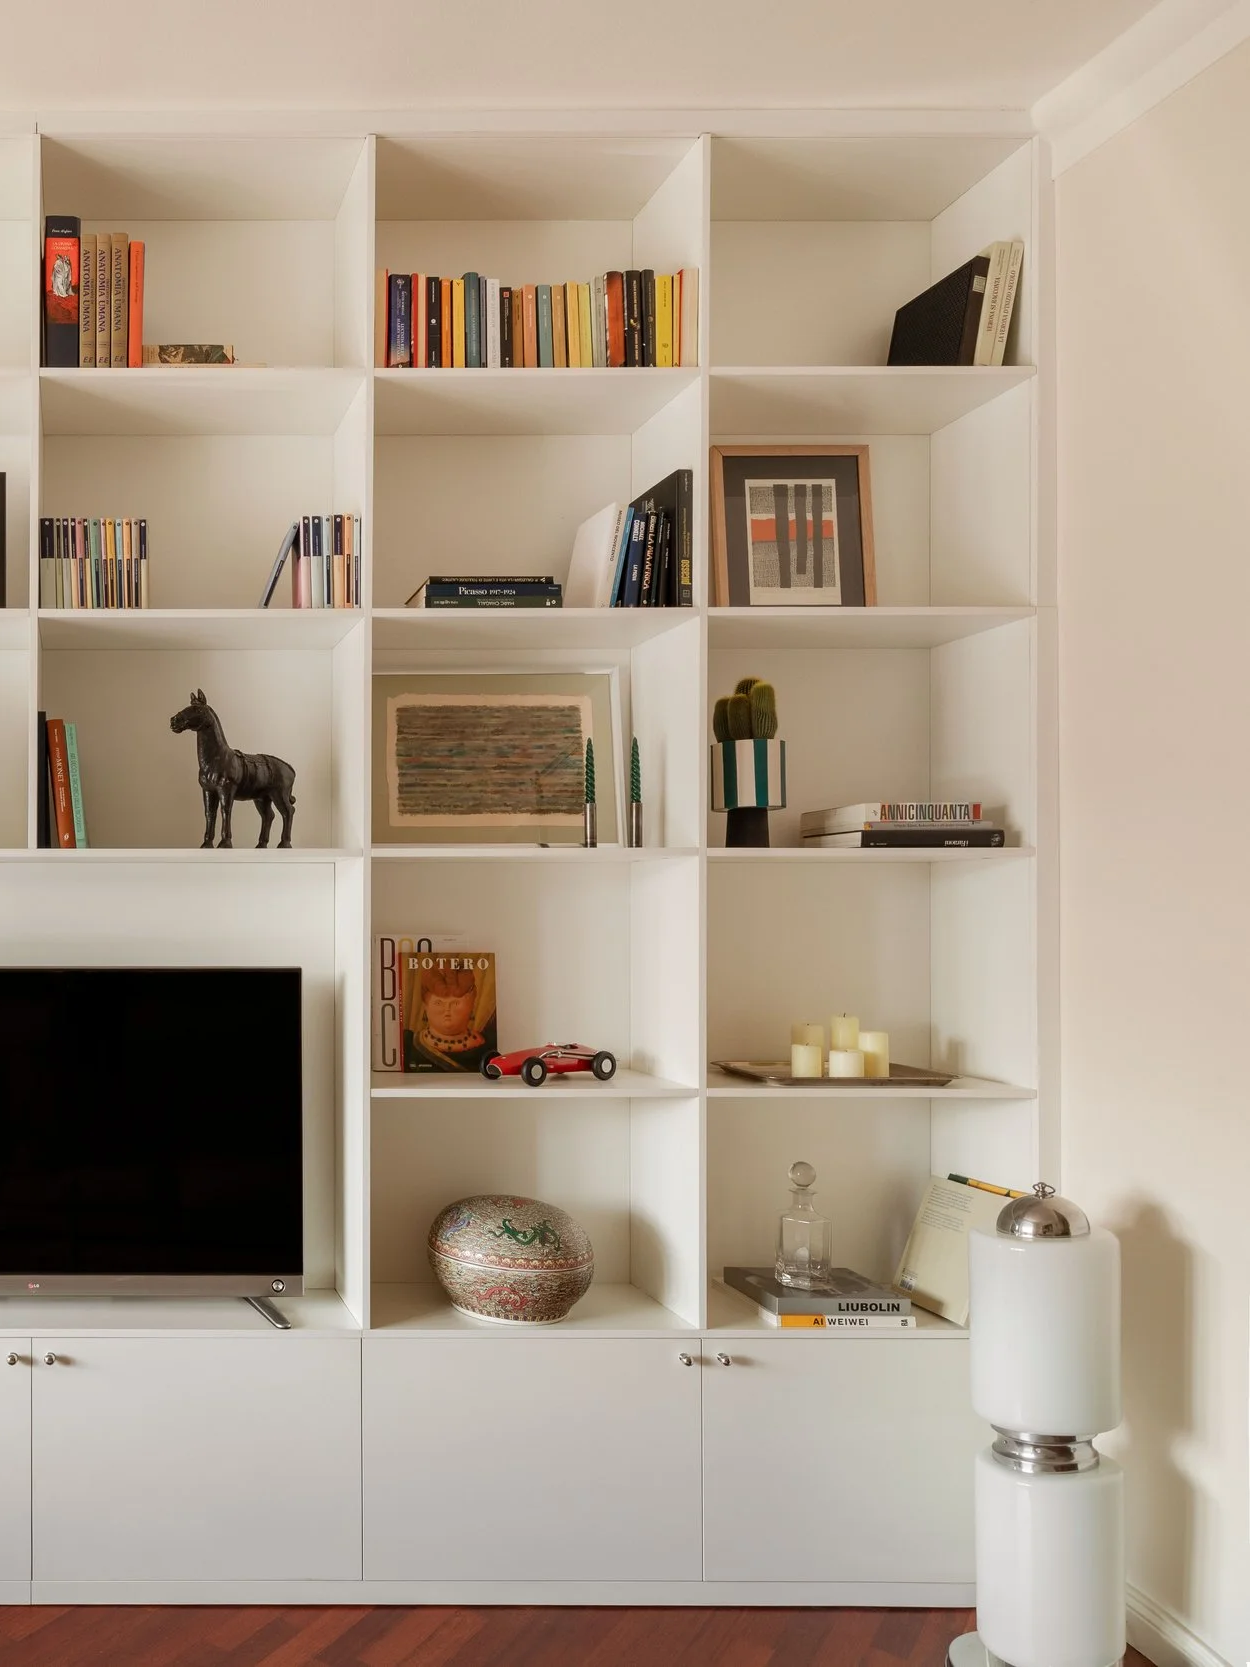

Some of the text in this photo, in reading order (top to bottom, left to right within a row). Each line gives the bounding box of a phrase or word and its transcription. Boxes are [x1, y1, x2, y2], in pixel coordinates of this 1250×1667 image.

[632, 520, 640, 542] CONNELLY
[648, 534, 654, 544] LA
[610, 535, 619, 562] NOVECENTO
[643, 560, 651, 590] AFRICA
[458, 587, 487, 595] Picasso
[56, 758, 64, 783] MONET
[880, 804, 970, 821] ANNICINQUANTA
[408, 958, 489, 970] BOTERO
[838, 1303, 900, 1312] LIUBOLIN
[813, 1318, 868, 1326] AI WEIWEI
